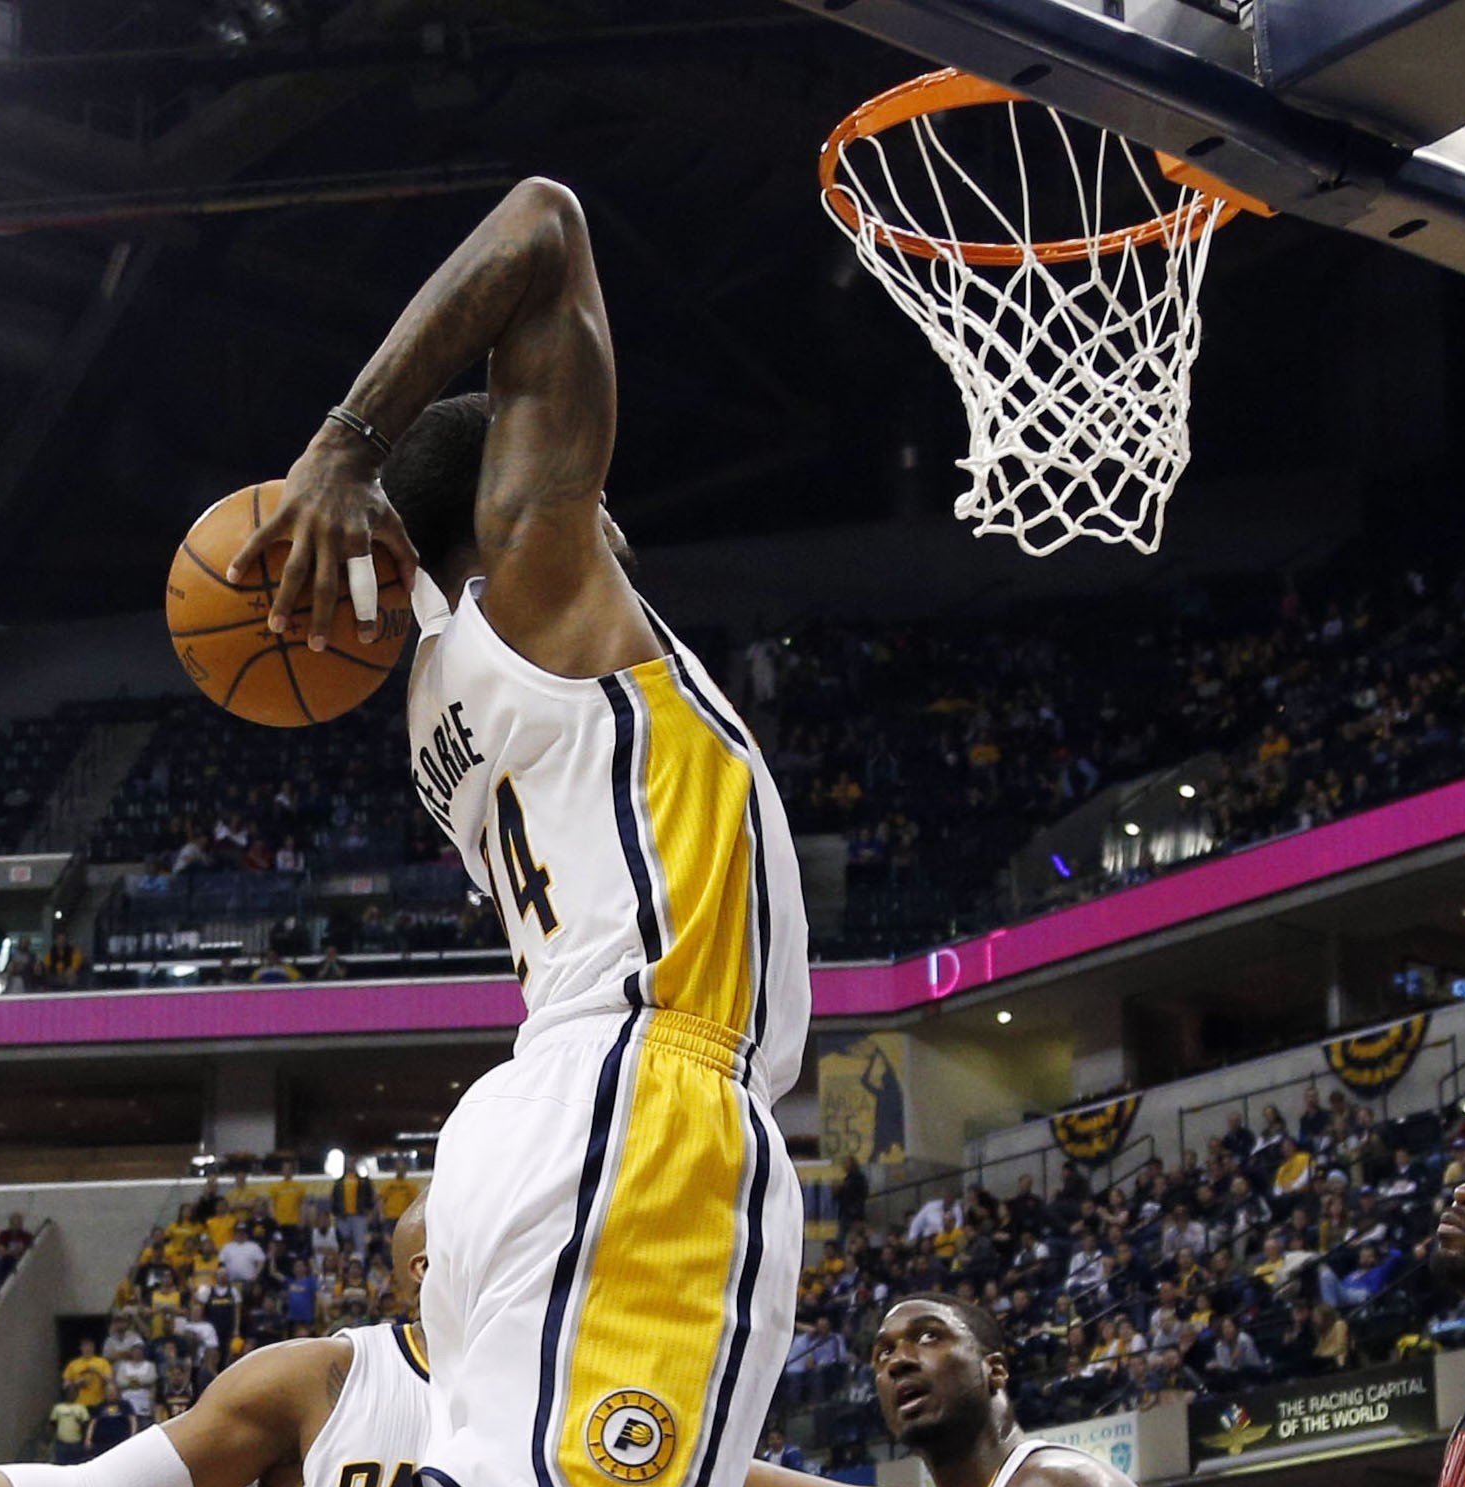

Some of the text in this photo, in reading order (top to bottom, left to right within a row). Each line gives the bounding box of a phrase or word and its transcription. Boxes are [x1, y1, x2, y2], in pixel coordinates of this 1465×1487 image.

[1278, 1377, 1427, 1418] THE RACING CAPITAL
[1279, 1402, 1390, 1439] OF THE WORLD
